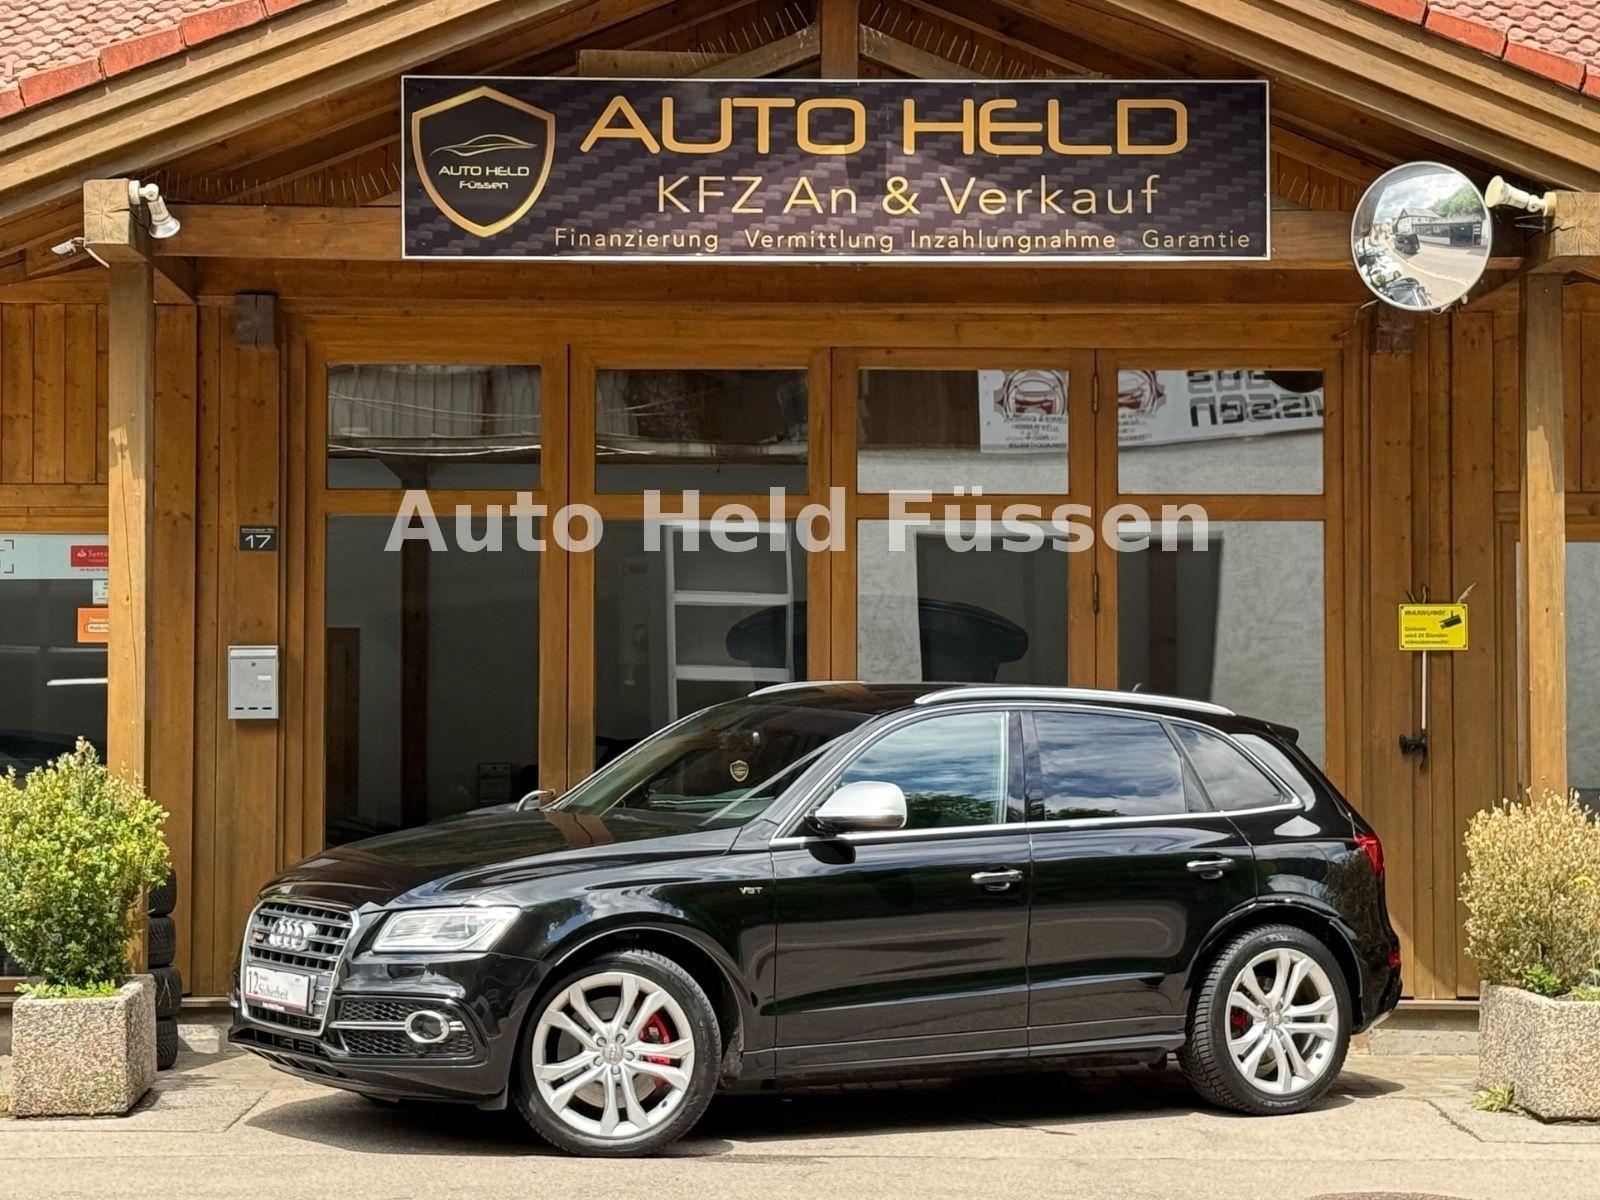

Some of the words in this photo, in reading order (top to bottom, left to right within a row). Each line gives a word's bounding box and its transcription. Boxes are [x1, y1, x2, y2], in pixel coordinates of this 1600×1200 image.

[579, 95, 868, 155] AUTO
[902, 97, 1189, 156] HELD
[438, 166, 483, 176] AUTO
[486, 166, 531, 176] HELD
[459, 178, 509, 191] Füssen
[657, 175, 765, 214] KFZ
[782, 175, 858, 214] An
[882, 176, 920, 215] &
[940, 174, 1161, 215] Verkauf
[554, 226, 719, 254] Finanzierung
[745, 227, 894, 253] Vermittlung
[911, 228, 1117, 253] Inzahlungnahme
[1142, 228, 1251, 249] Garantie
[244, 534, 272, 549] 17
[248, 970, 259, 995] 12
